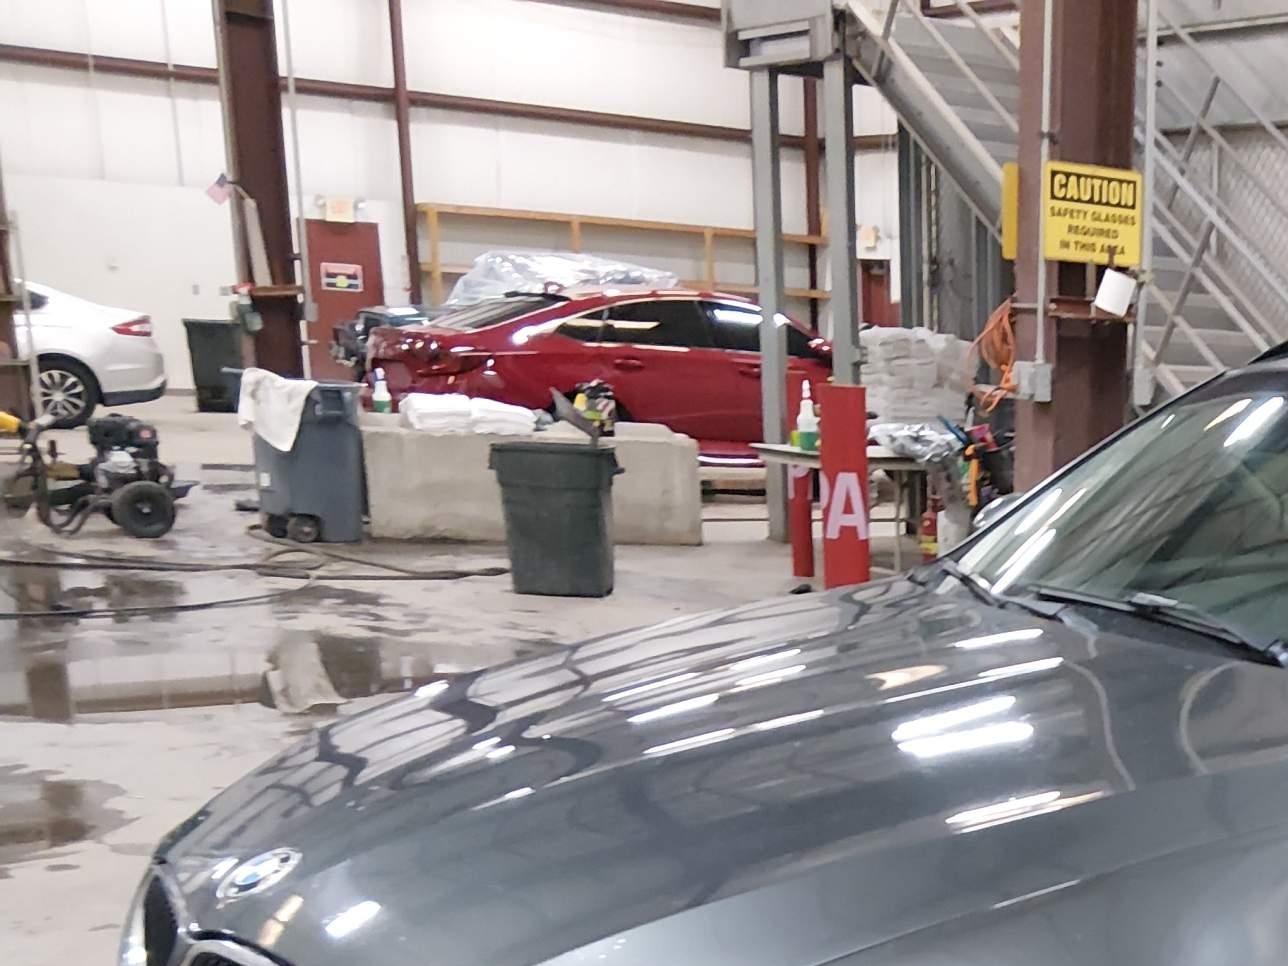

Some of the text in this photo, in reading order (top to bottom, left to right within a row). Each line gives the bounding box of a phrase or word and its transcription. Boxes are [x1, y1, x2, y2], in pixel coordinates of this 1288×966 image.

[1053, 173, 1135, 207] CAUTION
[1049, 206, 1137, 226] SAFETY GLASSES
[1066, 223, 1119, 239] REQUIRED
[1059, 239, 1071, 250] IN
[1073, 240, 1097, 253] THIS
